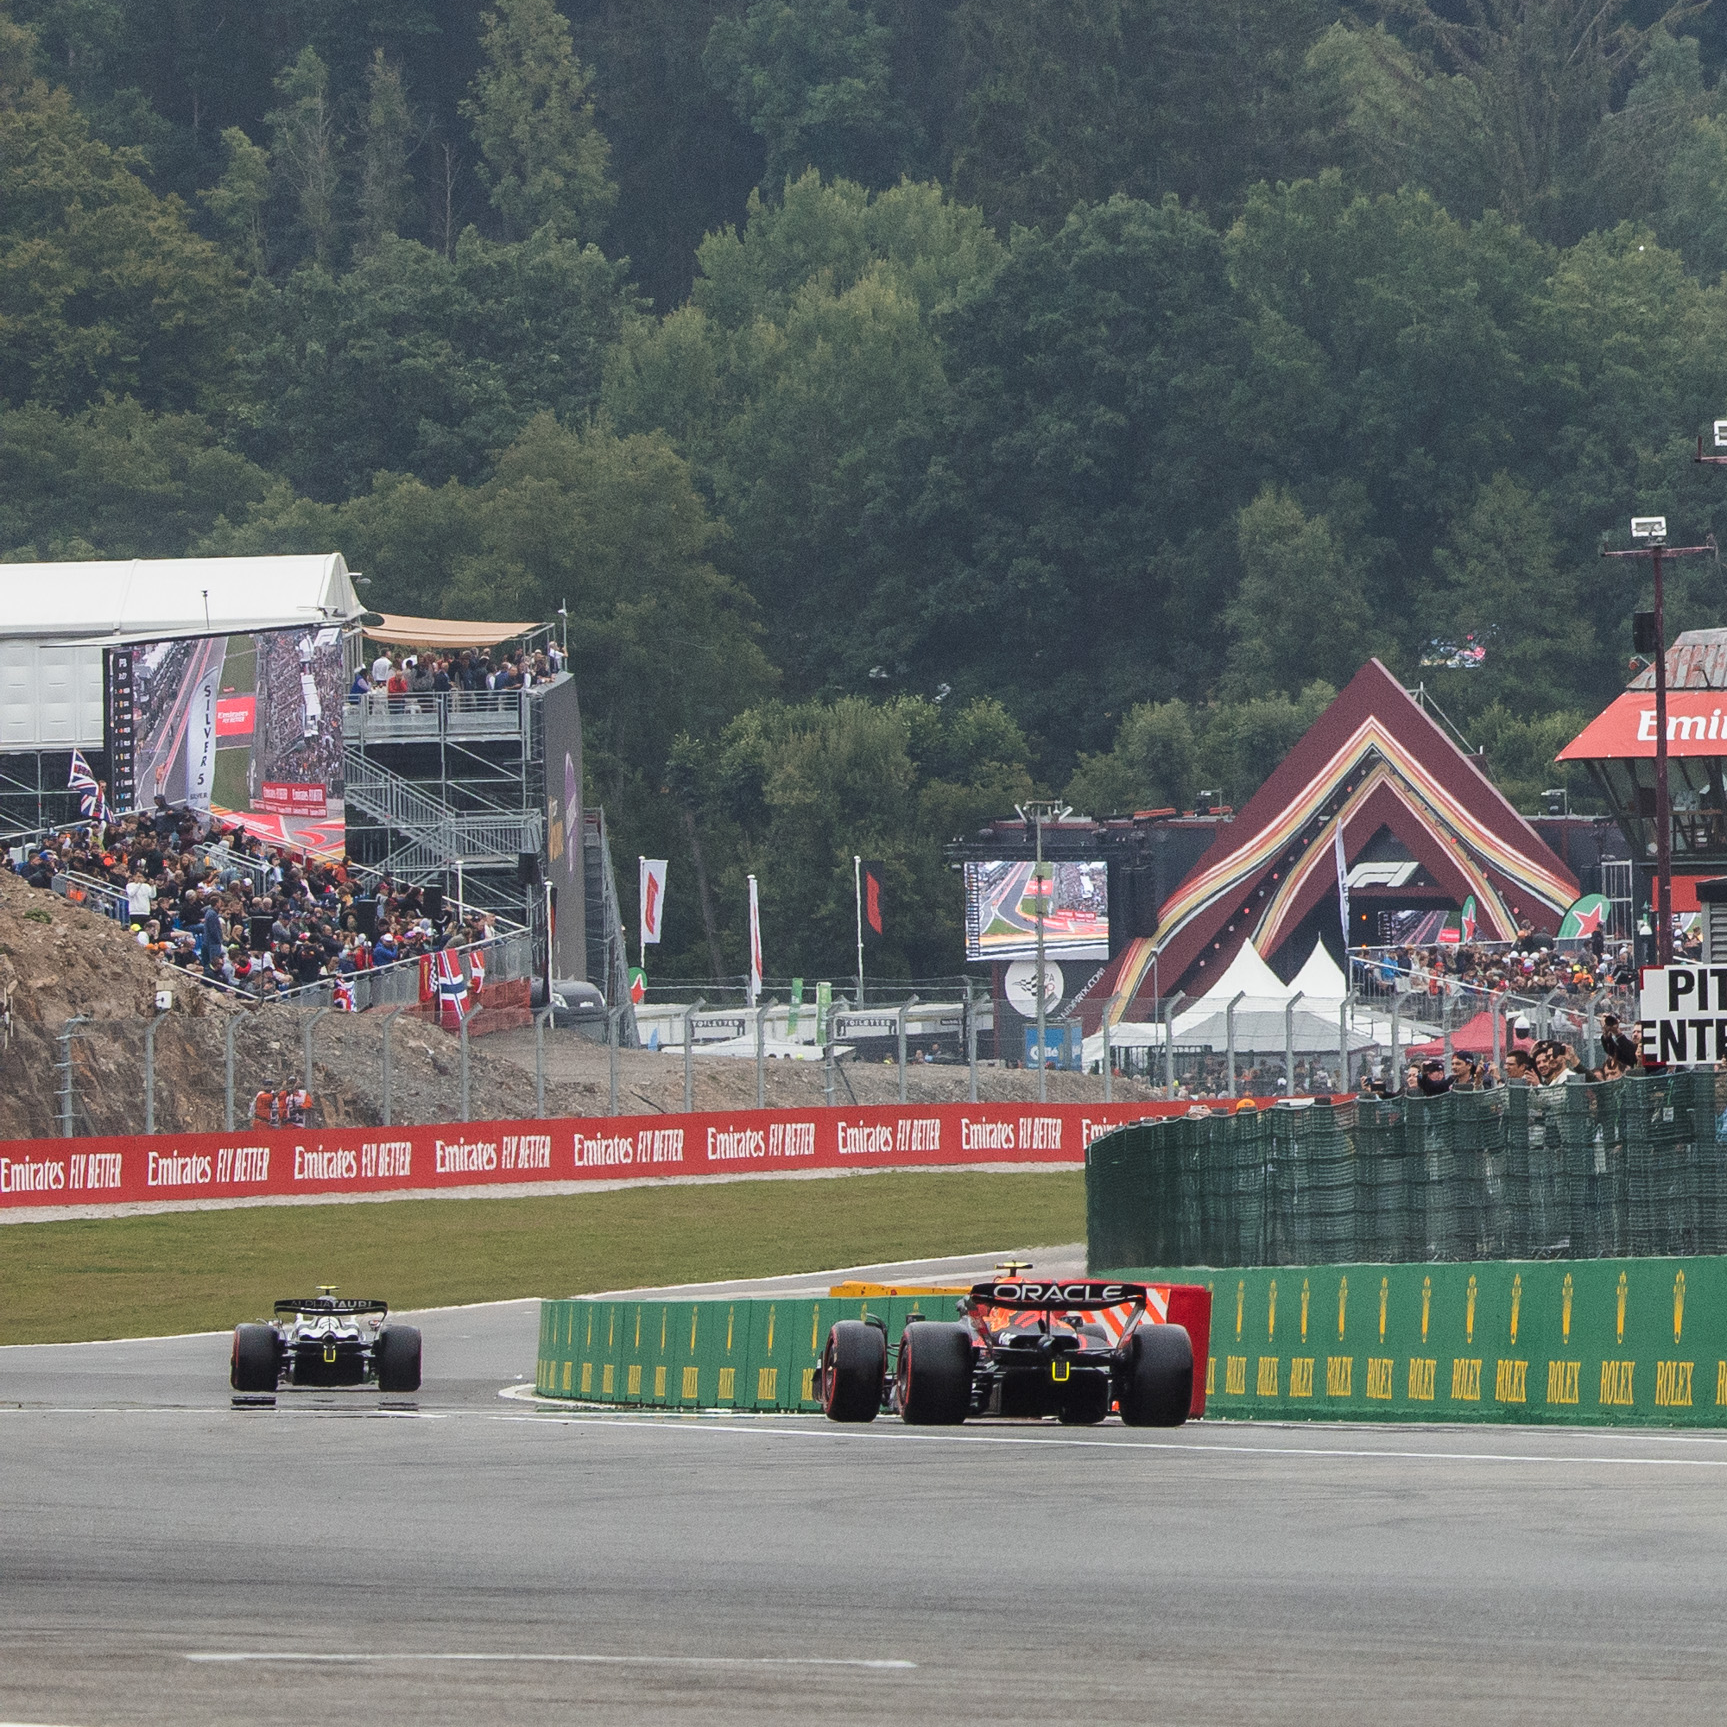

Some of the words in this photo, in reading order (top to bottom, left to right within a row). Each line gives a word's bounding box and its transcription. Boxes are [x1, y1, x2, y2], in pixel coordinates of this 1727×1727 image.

[574, 1132, 633, 1166] Emirates
[637, 1130, 652, 1162] FLY
[653, 1129, 683, 1161] BETTER
[707, 1126, 764, 1160] Emirates
[769, 1124, 784, 1157] FLY
[785, 1123, 815, 1156] BETTER
[838, 1120, 893, 1154] Emirates
[897, 1120, 911, 1151] FLY
[912, 1119, 940, 1150] BETTER
[961, 1117, 1014, 1150] Emirates
[1019, 1119, 1032, 1149] FLY
[1033, 1118, 1061, 1148] BETTER
[0, 1156, 64, 1192] Emirates
[69, 1155, 86, 1189] FLY
[87, 1154, 122, 1188] BETTER
[148, 1150, 211, 1186] Emirates
[217, 1149, 234, 1182] FLY
[235, 1148, 269, 1181] BETTER
[294, 1145, 357, 1180] Emirates
[362, 1143, 378, 1177] FLY
[379, 1142, 411, 1176] BETTER
[436, 1137, 497, 1173] Emirates
[502, 1136, 517, 1169] FLY
[519, 1135, 550, 1168] BETTER
[993, 1284, 1123, 1301] ORACLE
[1451, 1359, 1482, 1401] ROLEX
[1495, 1360, 1528, 1403] ROLEX
[1547, 1361, 1581, 1404] ROLEX
[1600, 1361, 1635, 1405] ROLEX
[1655, 1361, 1694, 1406] ROLEX
